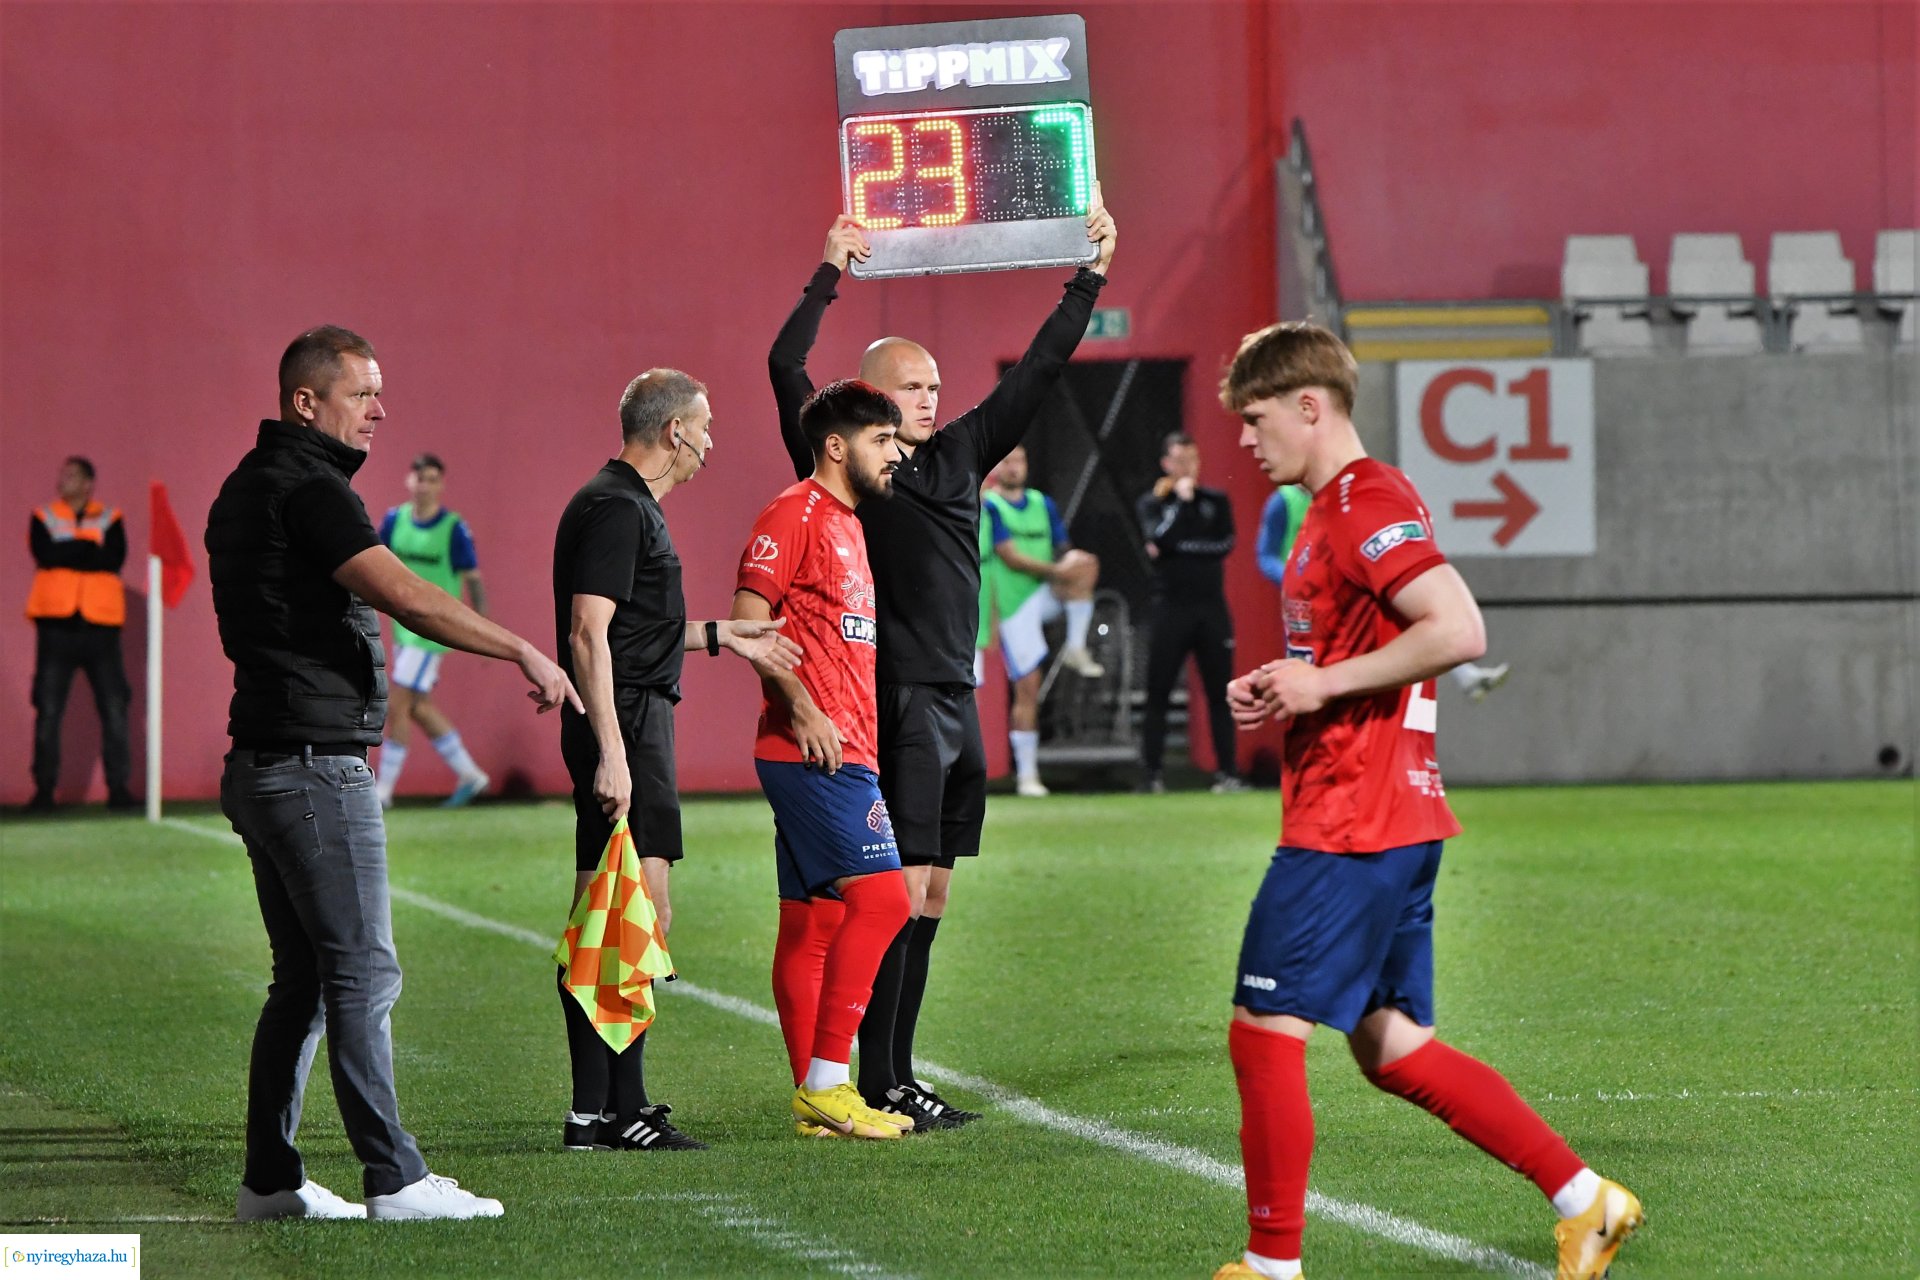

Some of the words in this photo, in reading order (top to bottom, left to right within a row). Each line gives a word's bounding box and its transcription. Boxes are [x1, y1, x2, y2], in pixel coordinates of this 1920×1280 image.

[853, 122, 966, 231] 23
[1033, 111, 1087, 214] 7
[1420, 367, 1570, 464] C1
[1242, 974, 1277, 991] JAKO
